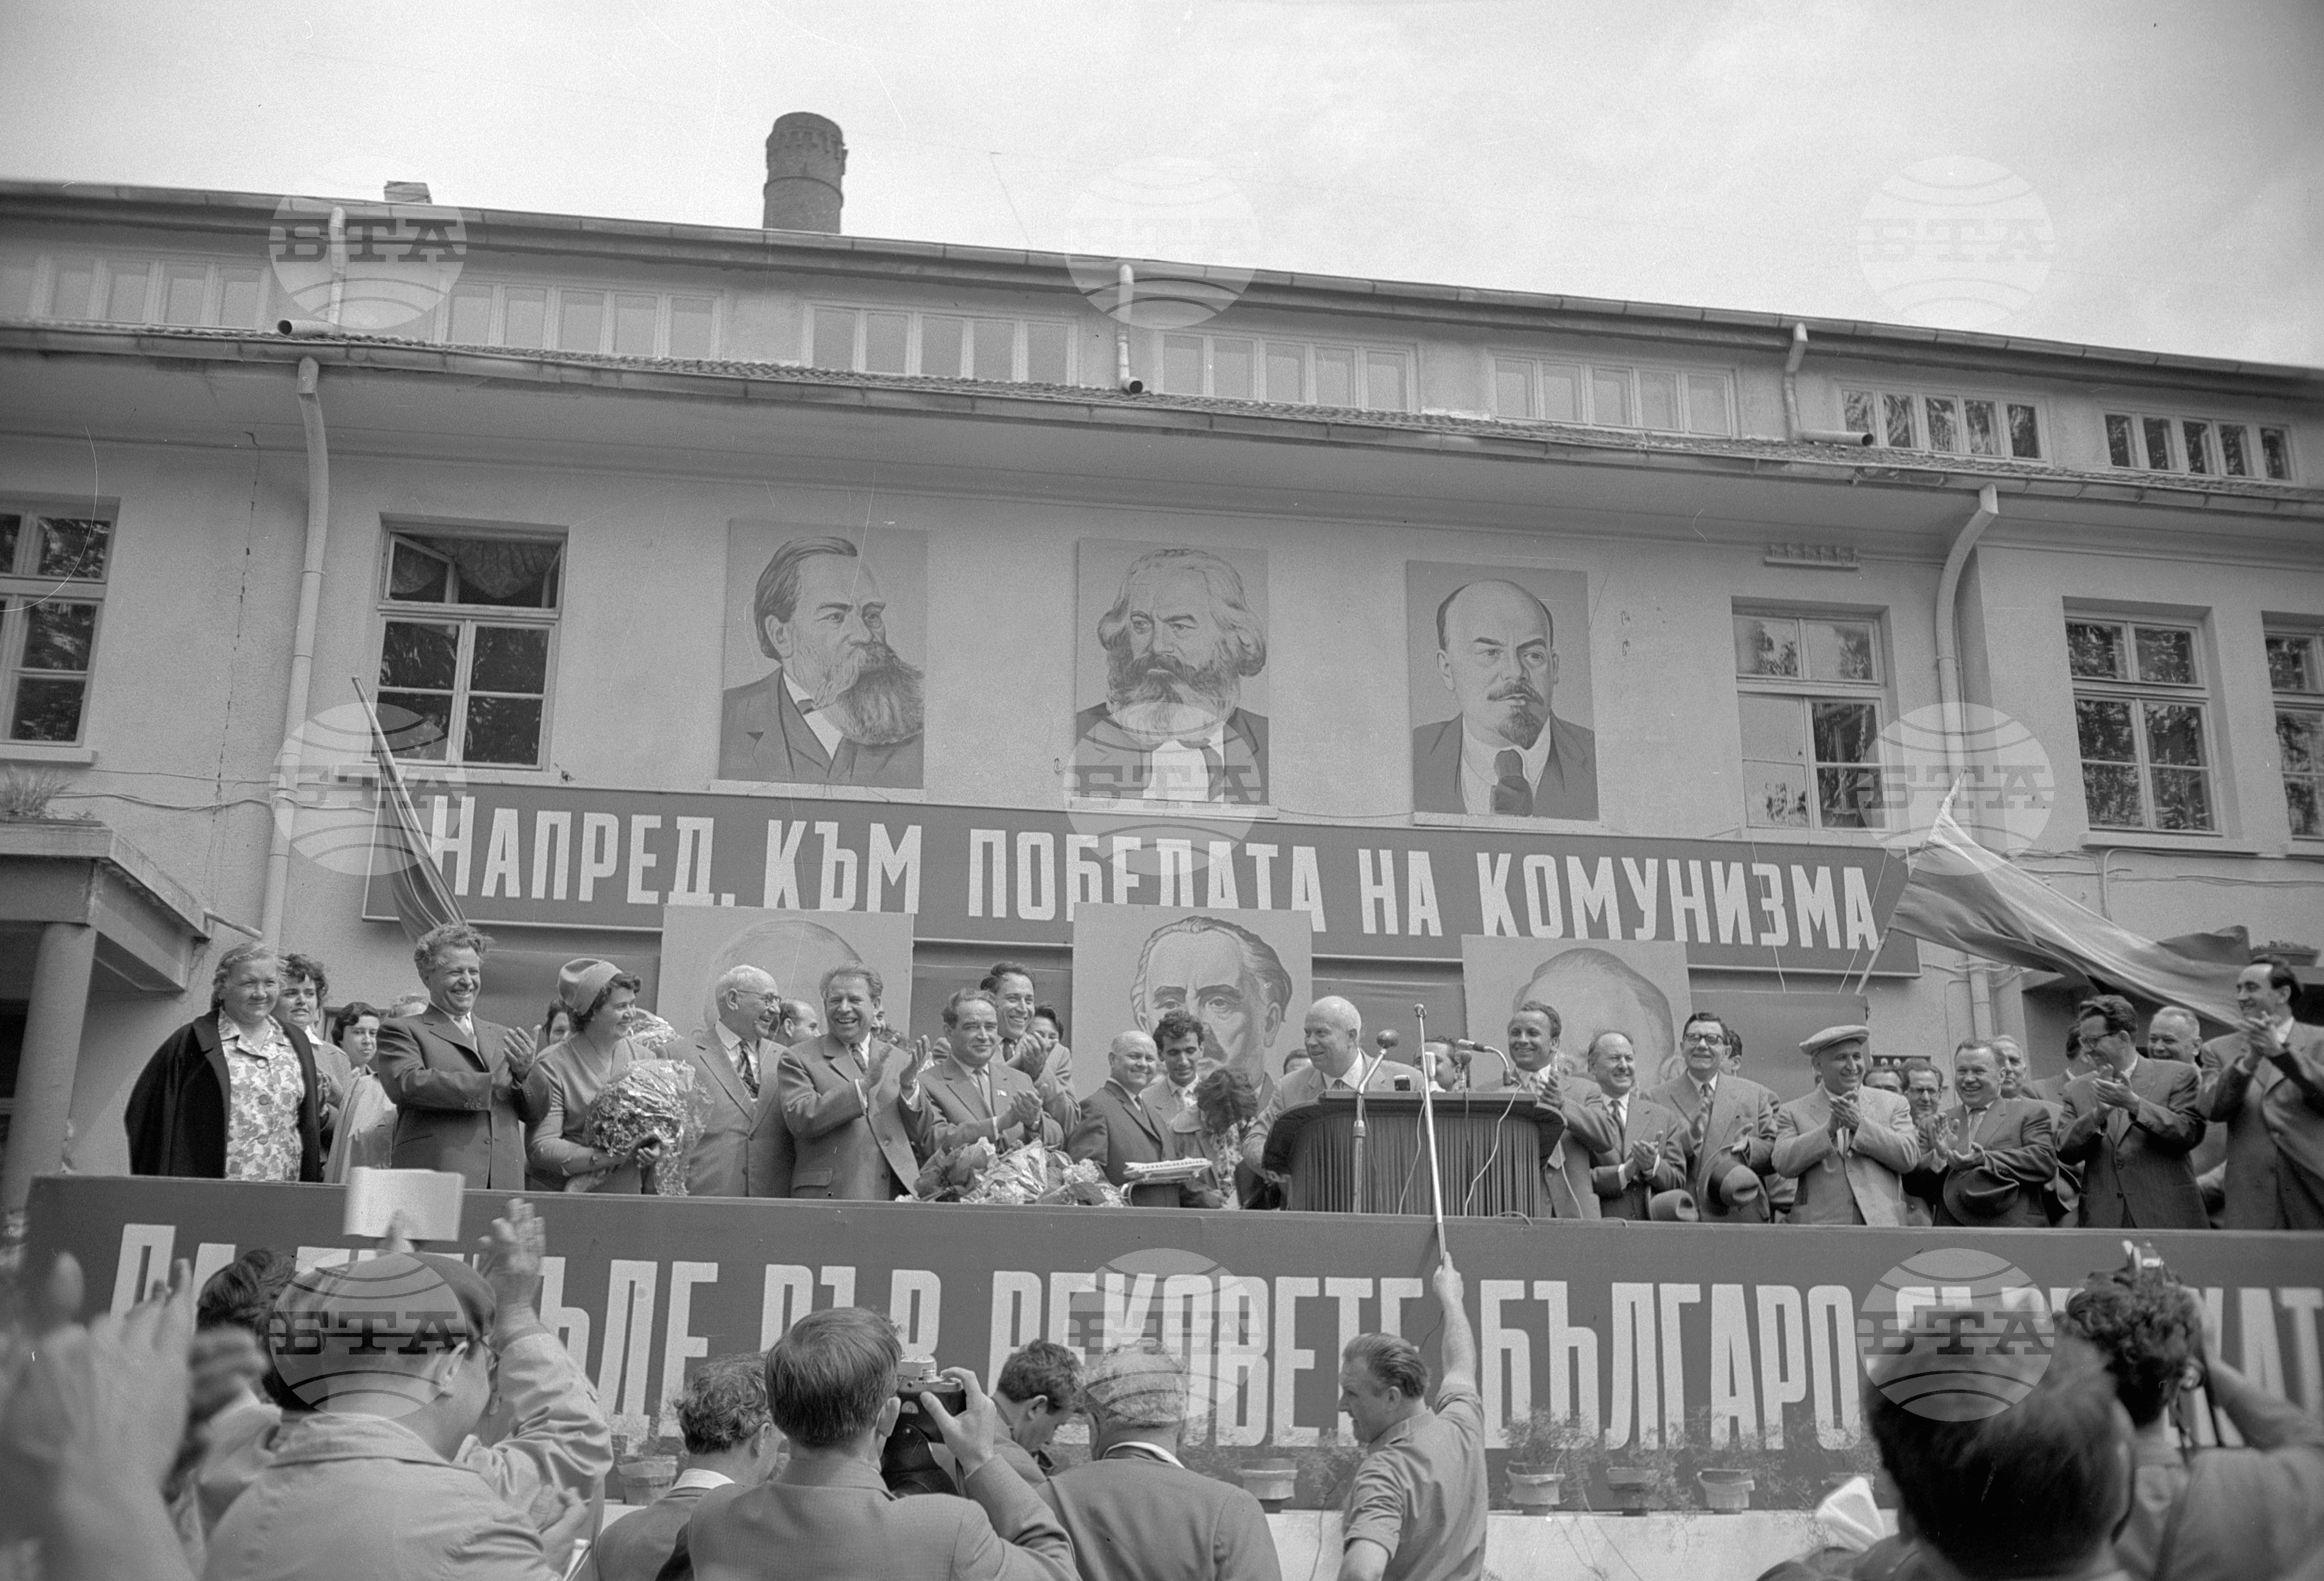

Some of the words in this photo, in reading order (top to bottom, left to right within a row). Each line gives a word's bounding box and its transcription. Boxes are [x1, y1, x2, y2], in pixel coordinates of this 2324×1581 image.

[763, 819, 921, 914] КЪМ
[969, 829, 1326, 932] ПОБЕДАТА
[1358, 848, 1443, 937] НА
[1476, 852, 1880, 951] КОМУНИЗМА
